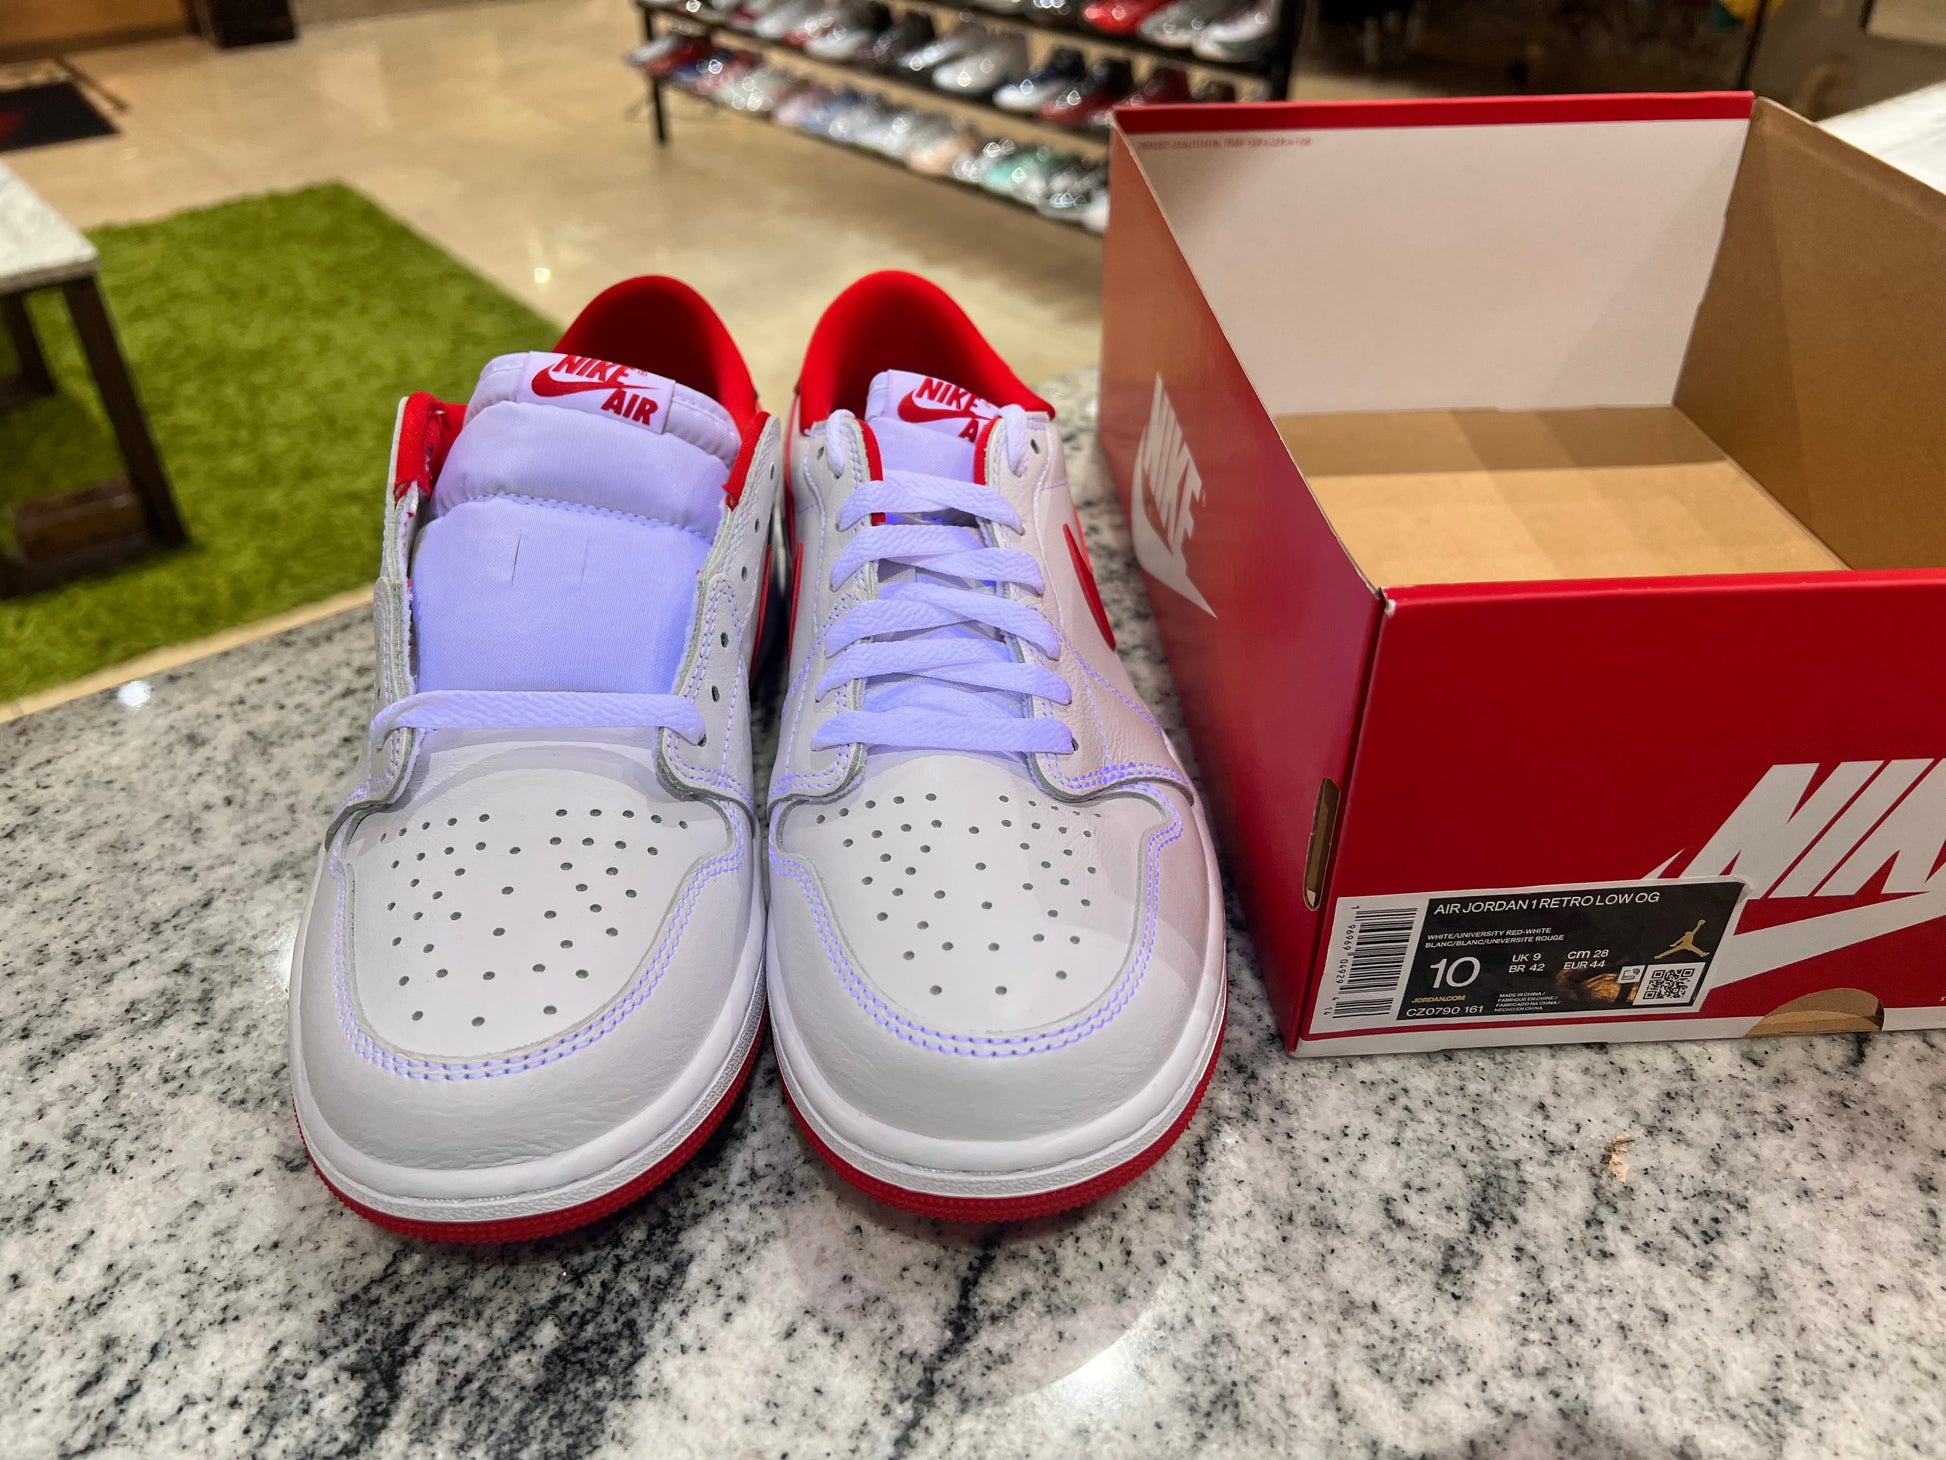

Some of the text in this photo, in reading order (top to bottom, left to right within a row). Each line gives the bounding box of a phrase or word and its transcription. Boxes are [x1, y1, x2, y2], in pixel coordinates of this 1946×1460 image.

[552, 354, 634, 388] NIKE
[915, 377, 979, 418] NIKE
[600, 388, 659, 426] AIR
[1142, 371, 1202, 575] NIKE
[1678, 757, 1946, 900] NIK
[1434, 892, 1660, 915] AIR JORDAN 1 RETRO LOW OG
[1343, 924, 1356, 951] 96969
[1425, 934, 1565, 948] BLANC/BLANC/UNIVERSITE ROUGE
[1427, 927, 1552, 940] WHITE/UNIVERSITY RED-WHITE
[1512, 953, 1542, 962] UK 9
[1592, 949, 1609, 958] 28
[1430, 956, 1481, 989] 10
[1508, 963, 1546, 973] BR 42
[1563, 960, 1606, 970] EUR 44
[1411, 995, 1466, 1004] JORDAN.COM
[1405, 1005, 1484, 1017] CZ0790 161
